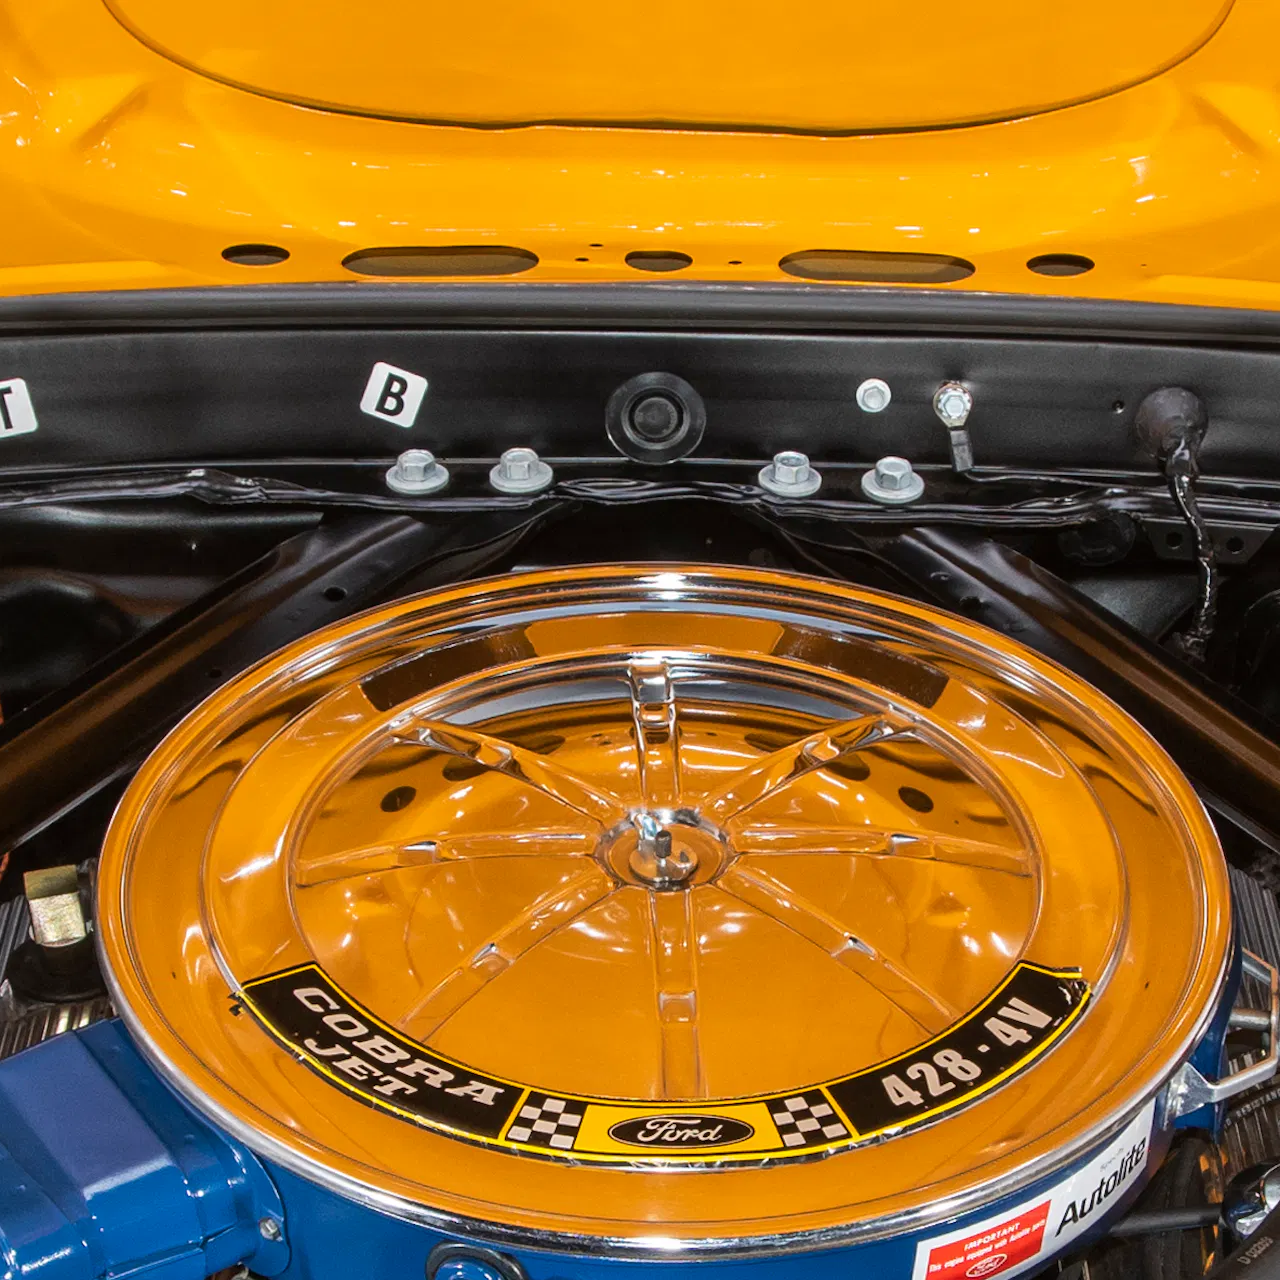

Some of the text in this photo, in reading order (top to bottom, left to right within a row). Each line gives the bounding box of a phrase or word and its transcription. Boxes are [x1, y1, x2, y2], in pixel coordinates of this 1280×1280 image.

[374, 372, 405, 418] B
[292, 986, 505, 1106] COBRA
[303, 1037, 418, 1096] JET
[881, 997, 1053, 1108] 428 4V
[637, 1116, 723, 1143] Ford
[1055, 1137, 1147, 1237] Autolite
[962, 1221, 1022, 1252] IMPORTANT
